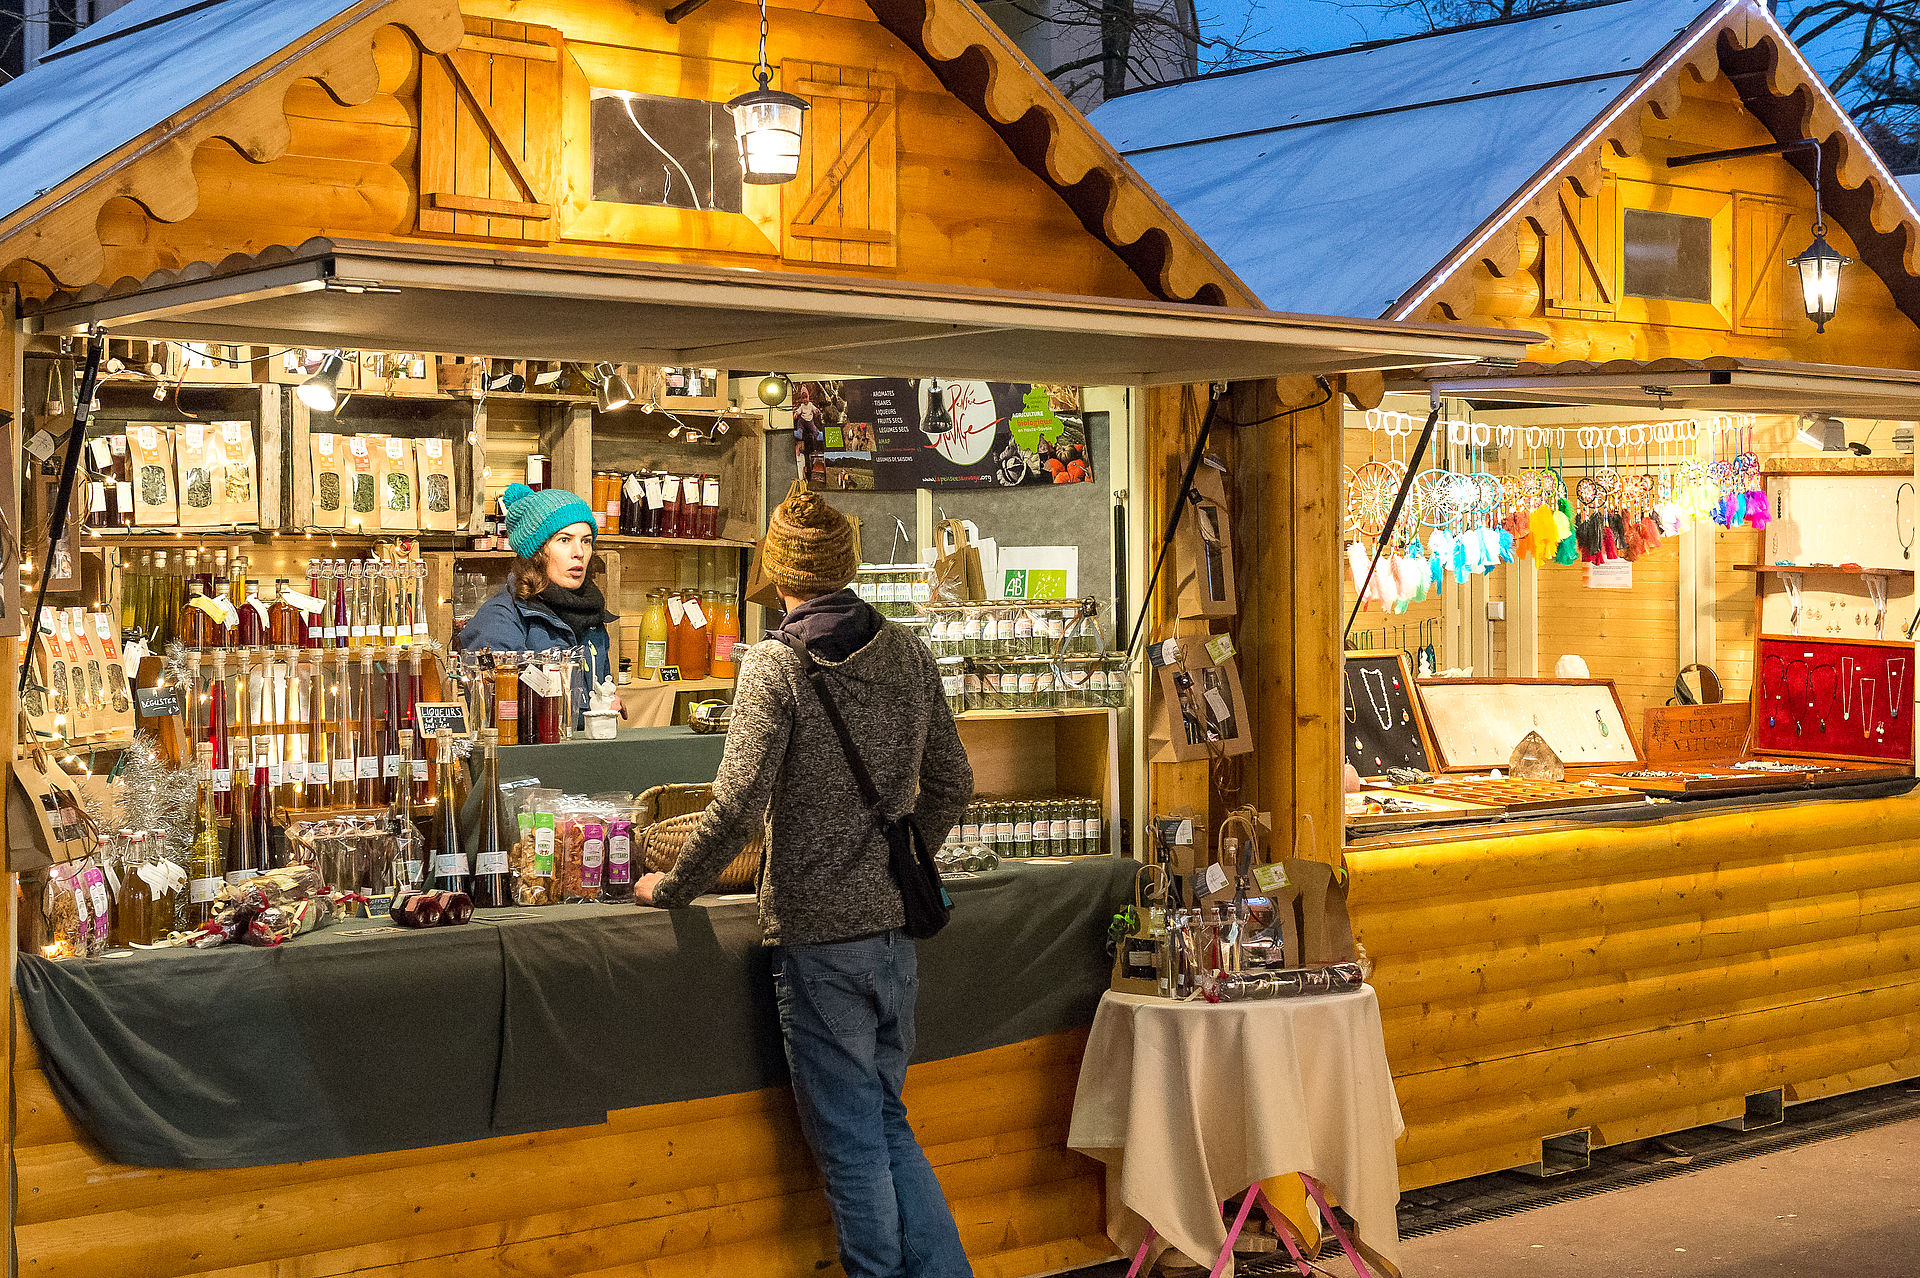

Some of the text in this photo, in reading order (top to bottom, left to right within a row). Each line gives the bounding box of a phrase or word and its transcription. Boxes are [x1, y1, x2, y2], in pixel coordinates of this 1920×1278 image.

[875, 408, 897, 416] LIQUEURS
[1016, 419, 1053, 427] biologique
[1005, 577, 1023, 596] AB
[141, 697, 177, 709] DÉGUSTER
[421, 707, 462, 716] LIQUEURS
